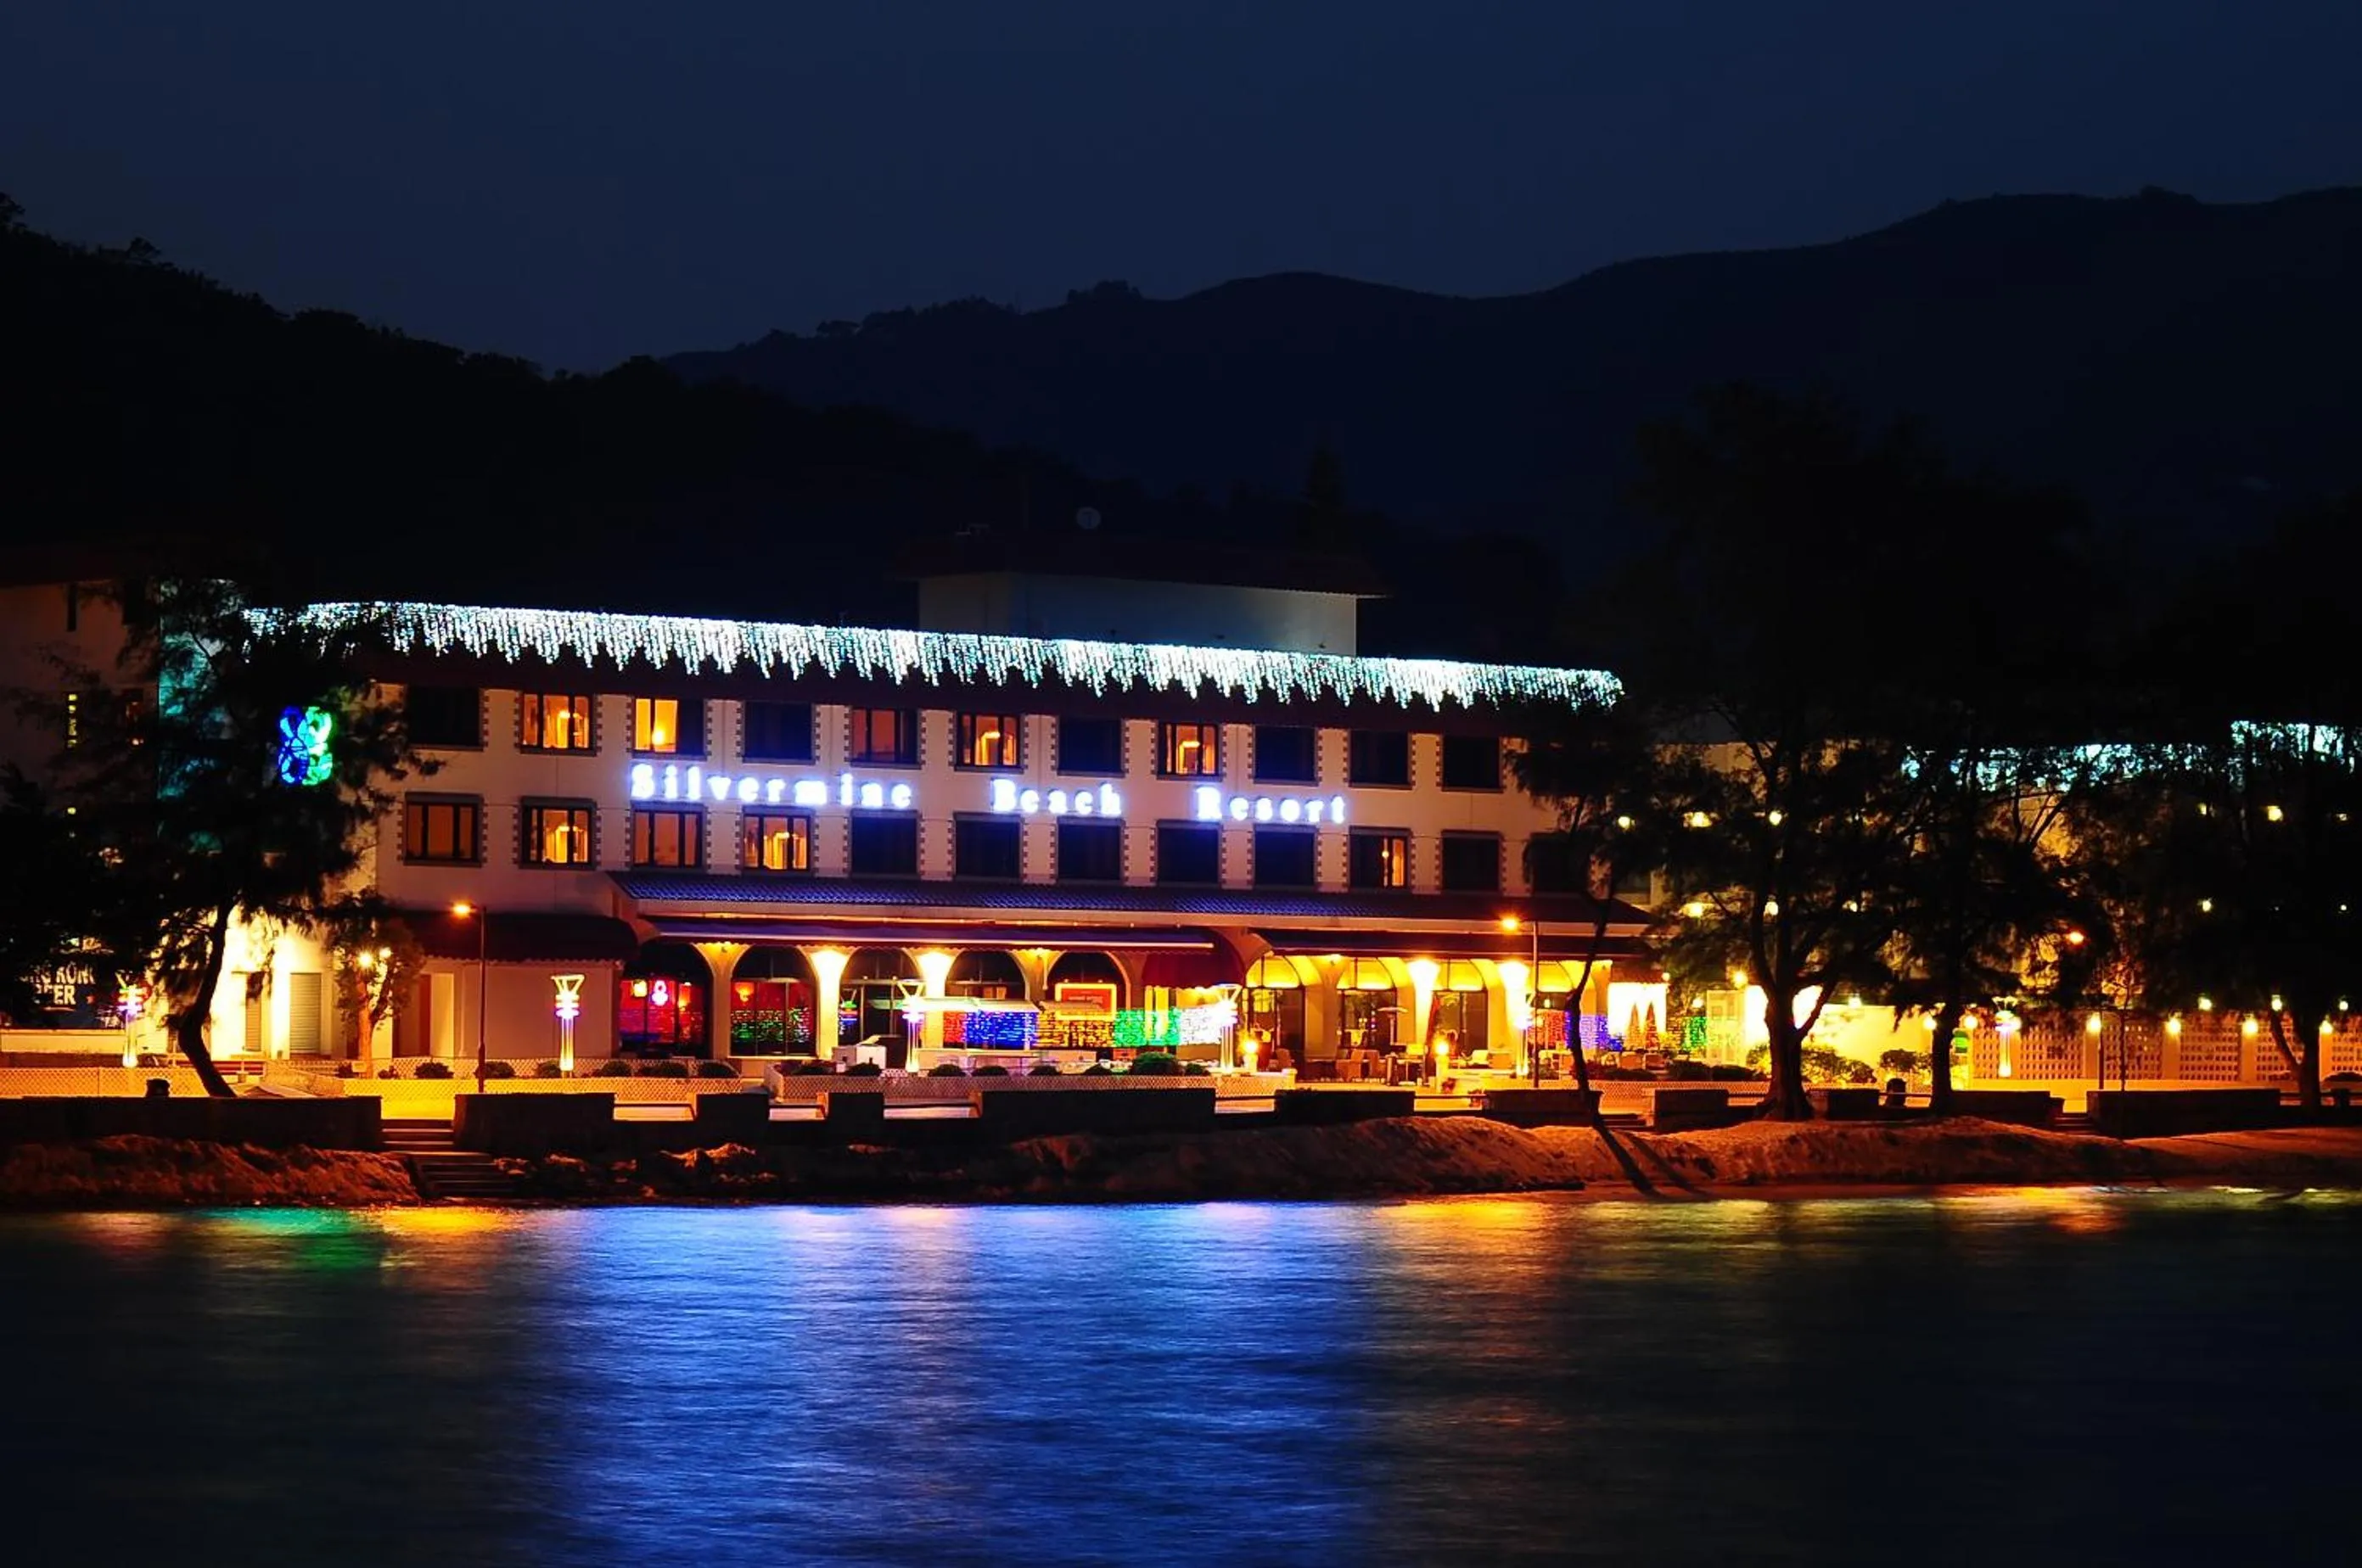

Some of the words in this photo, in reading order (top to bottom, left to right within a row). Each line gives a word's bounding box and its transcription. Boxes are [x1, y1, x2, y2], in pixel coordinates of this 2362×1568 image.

[631, 763, 912, 808] Silvermine
[991, 777, 1123, 816] Beach
[1196, 785, 1347, 824] Resort
